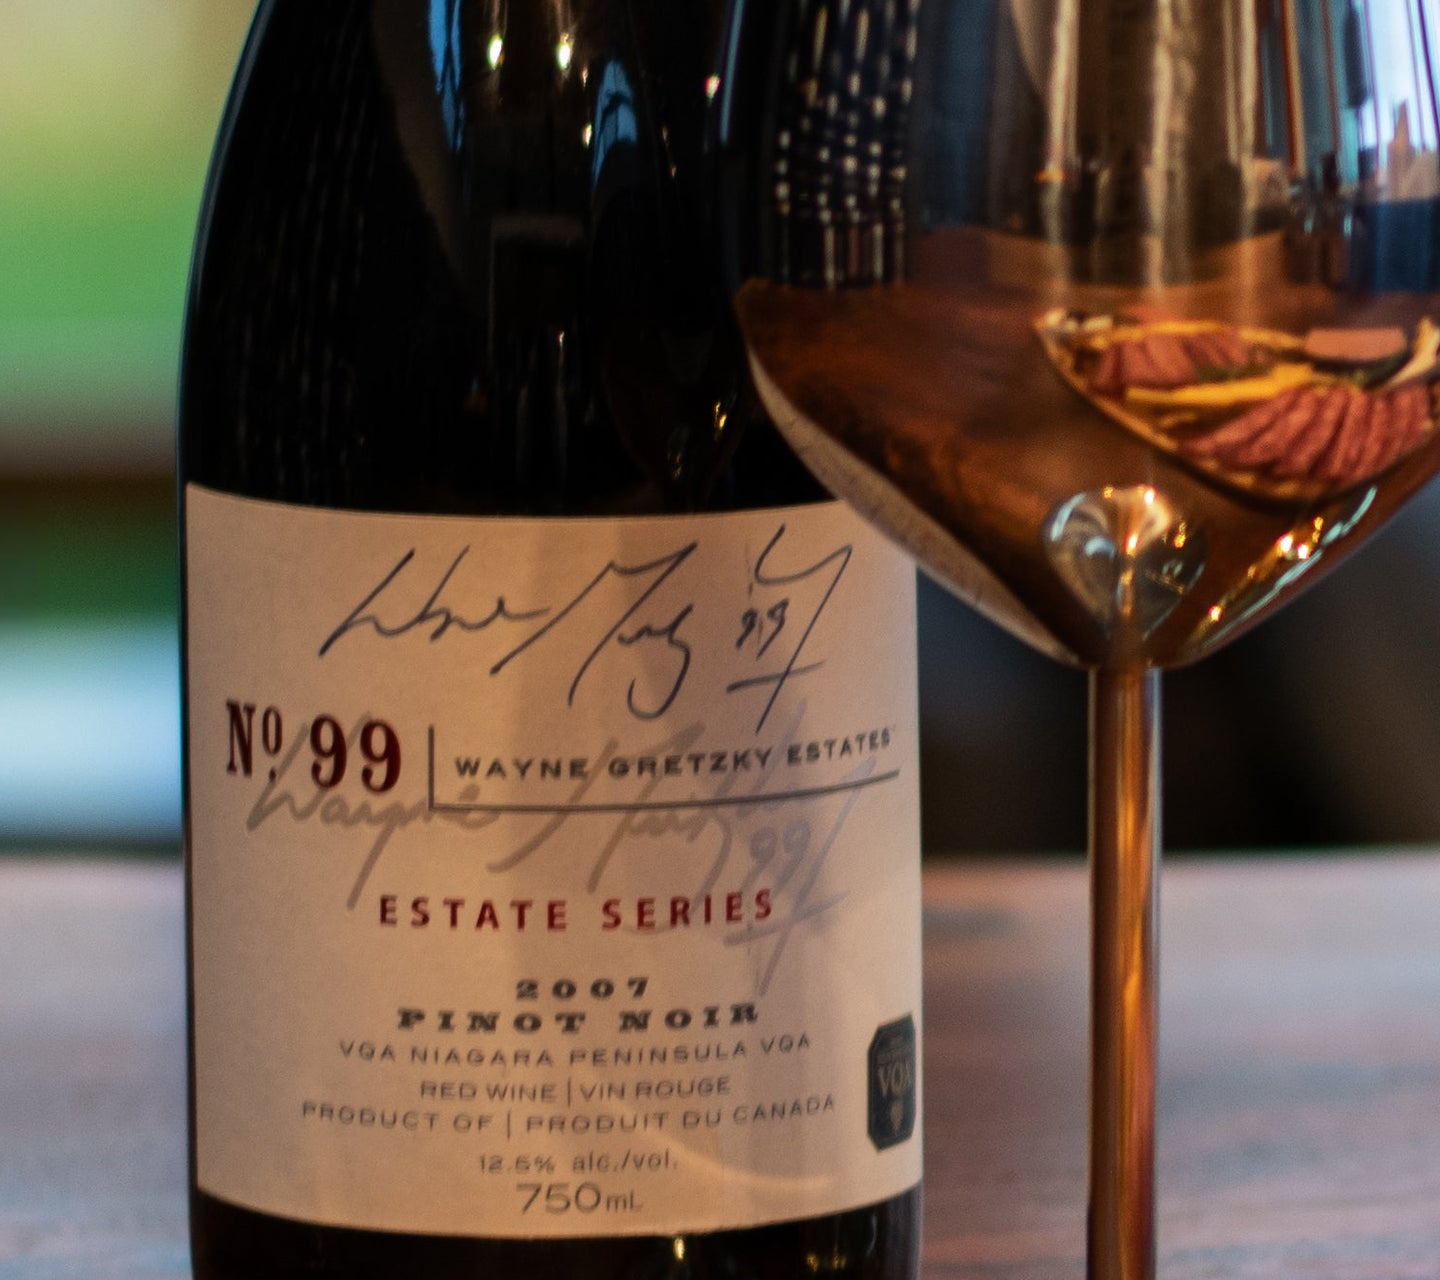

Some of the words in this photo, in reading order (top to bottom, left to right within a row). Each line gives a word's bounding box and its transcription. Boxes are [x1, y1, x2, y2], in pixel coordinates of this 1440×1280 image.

[309, 713, 402, 793] 99
[454, 756, 588, 781] WAYNE
[607, 746, 774, 778] GRETZKY
[787, 726, 891, 767] ESTATES
[379, 894, 568, 932] ESTATE
[601, 888, 773, 931] SERIES
[516, 977, 649, 1001] 2007
[397, 1007, 586, 1034] PINOT
[618, 1002, 759, 1033] NOIR
[410, 1045, 554, 1067] NIAGARA
[569, 1041, 747, 1067] PENINSULA
[420, 1081, 477, 1101] RED
[486, 1082, 558, 1102] WINE
[579, 1081, 626, 1102] VIN
[635, 1076, 731, 1101] ROUGE
[302, 1101, 440, 1132] PRODUCT
[453, 1114, 495, 1134] OF
[526, 1112, 670, 1135] PRODUIT
[682, 1108, 723, 1131] DU
[733, 1094, 836, 1122] CANADA
